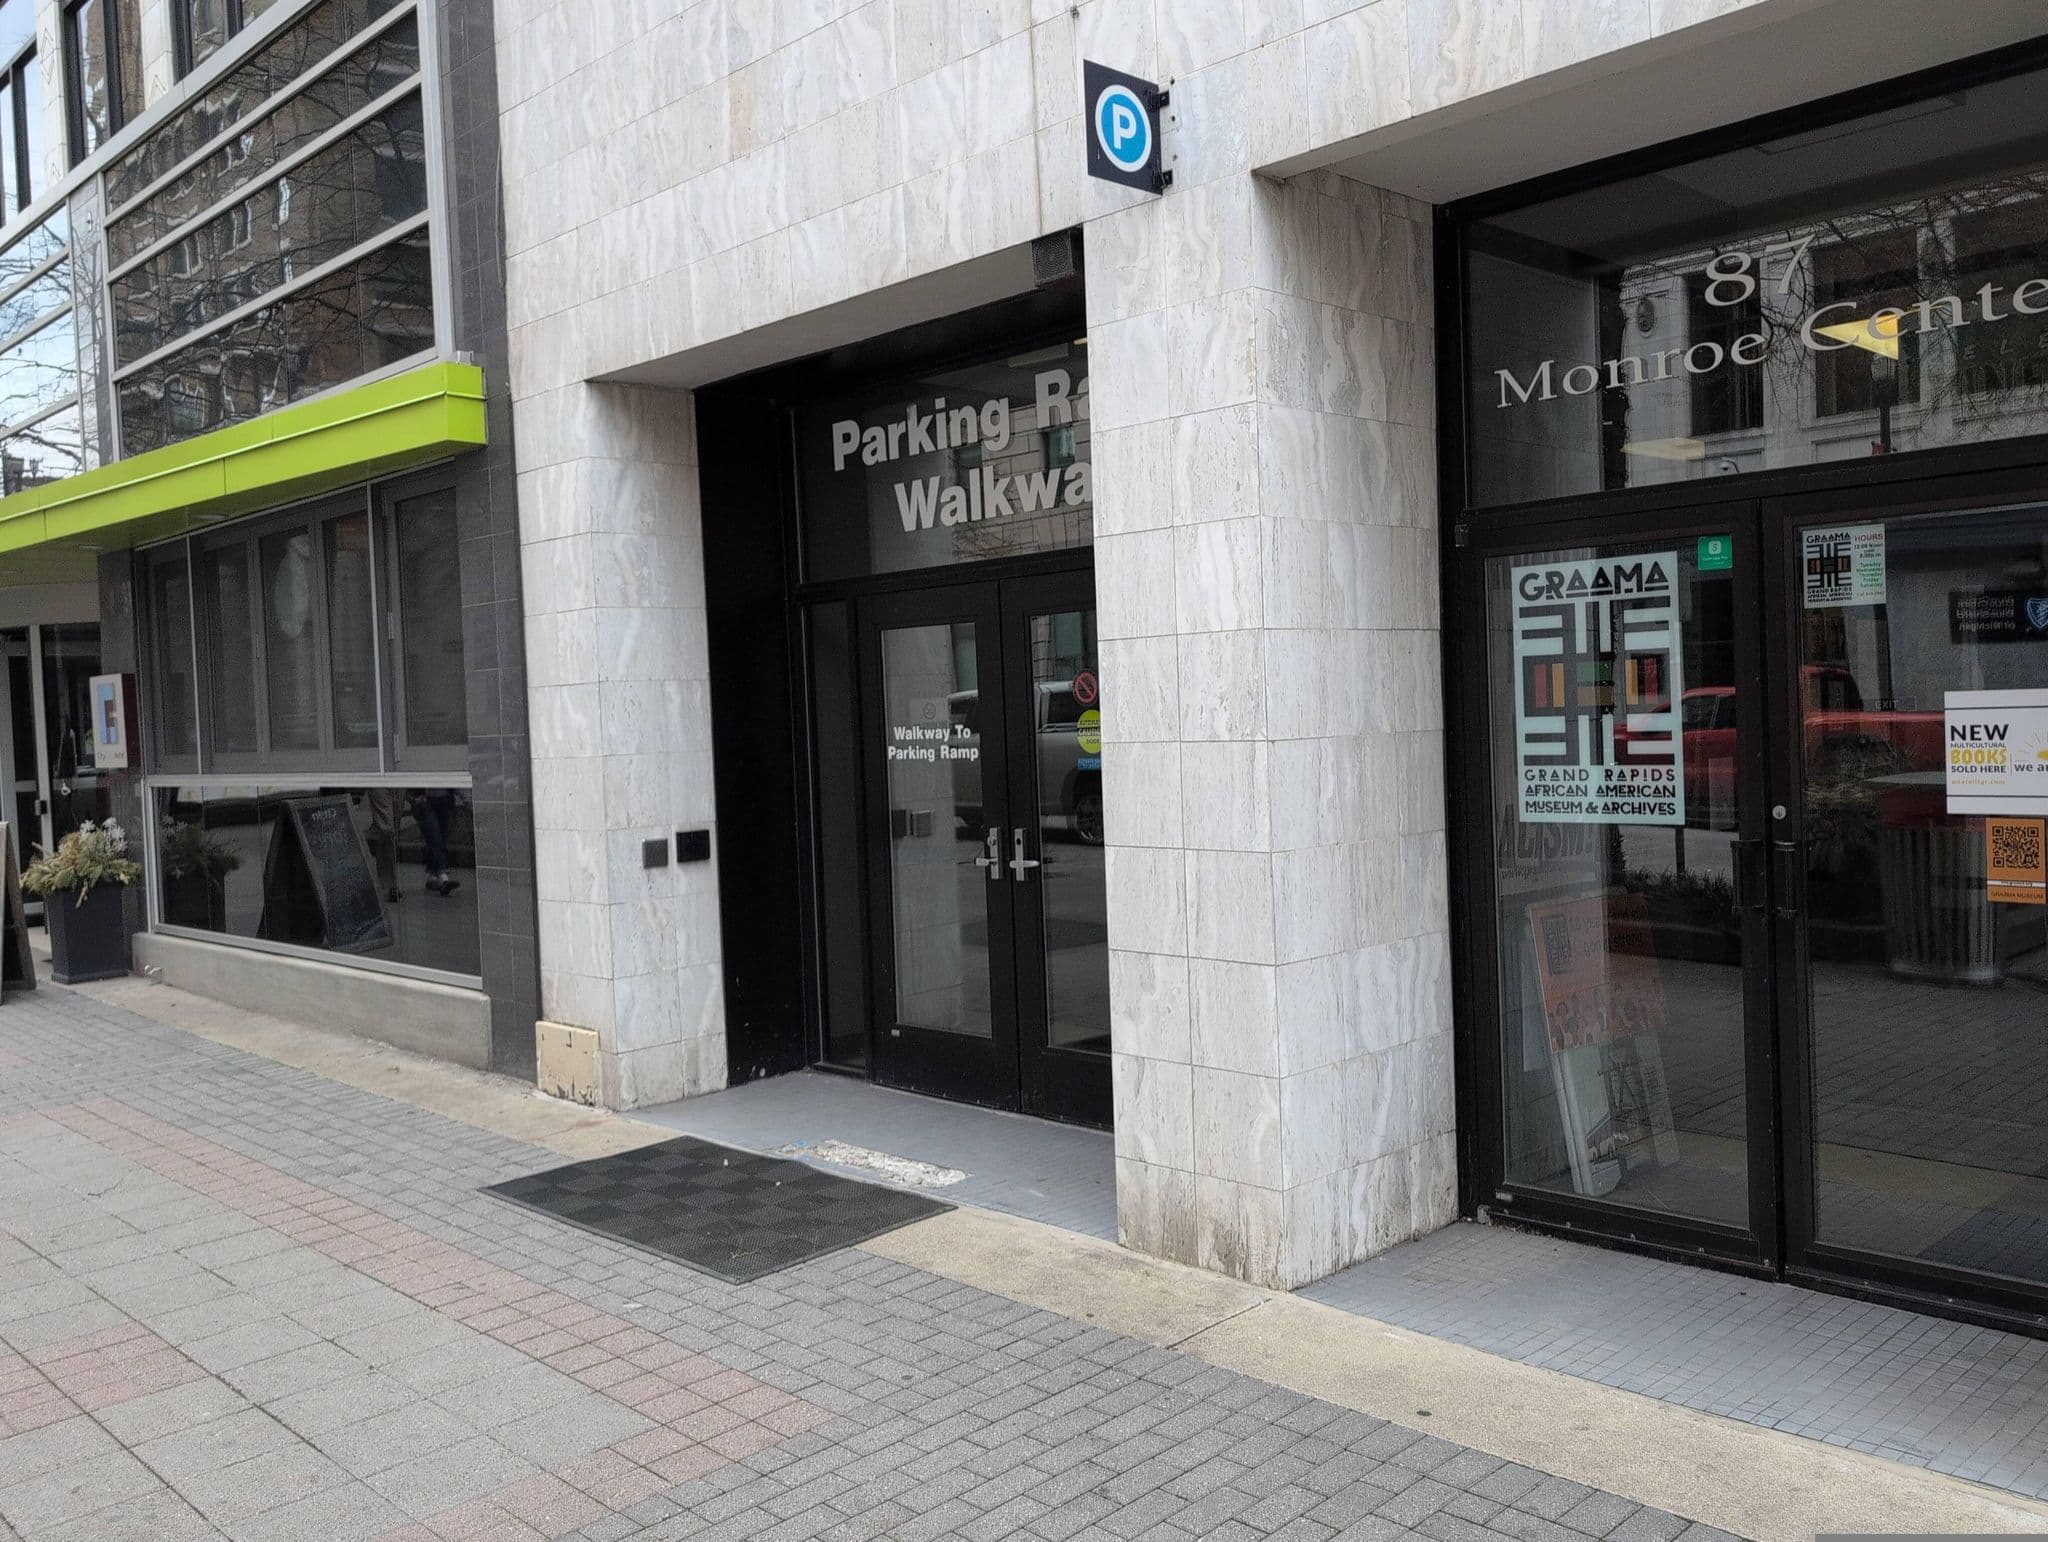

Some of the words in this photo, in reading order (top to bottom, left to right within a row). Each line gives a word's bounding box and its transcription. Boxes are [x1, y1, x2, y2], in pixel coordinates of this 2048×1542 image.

[1112, 104, 1137, 149] P
[1703, 233, 1818, 308] 87
[1494, 331, 1769, 410] Monroe
[1800, 278, 2048, 353] Cente
[832, 396, 1010, 473] Parking
[894, 462, 1092, 534] Walkwa
[1806, 532, 1851, 544] GRAAMA
[1855, 533, 1884, 542] HOURS
[1519, 560, 1670, 602] GRAAMA
[893, 725, 951, 743] Walkway
[955, 724, 972, 740] To
[1950, 724, 2010, 741] NEW
[887, 745, 936, 763] Parking
[940, 744, 980, 762] Ramp
[1951, 748, 2007, 764] BOOKS
[1524, 768, 1590, 783] GRAND
[1604, 767, 1676, 783] RAPIDS
[1951, 765, 1978, 774] SOLD
[1980, 765, 2007, 774] HERE
[2014, 763, 2034, 773] we
[1524, 784, 1589, 798] AFRICAN
[1595, 783, 1676, 799] AMERICAN
[1525, 800, 1583, 815] MUSEUM
[1585, 801, 1599, 815] &
[1601, 801, 1676, 816] ARCHIVES
